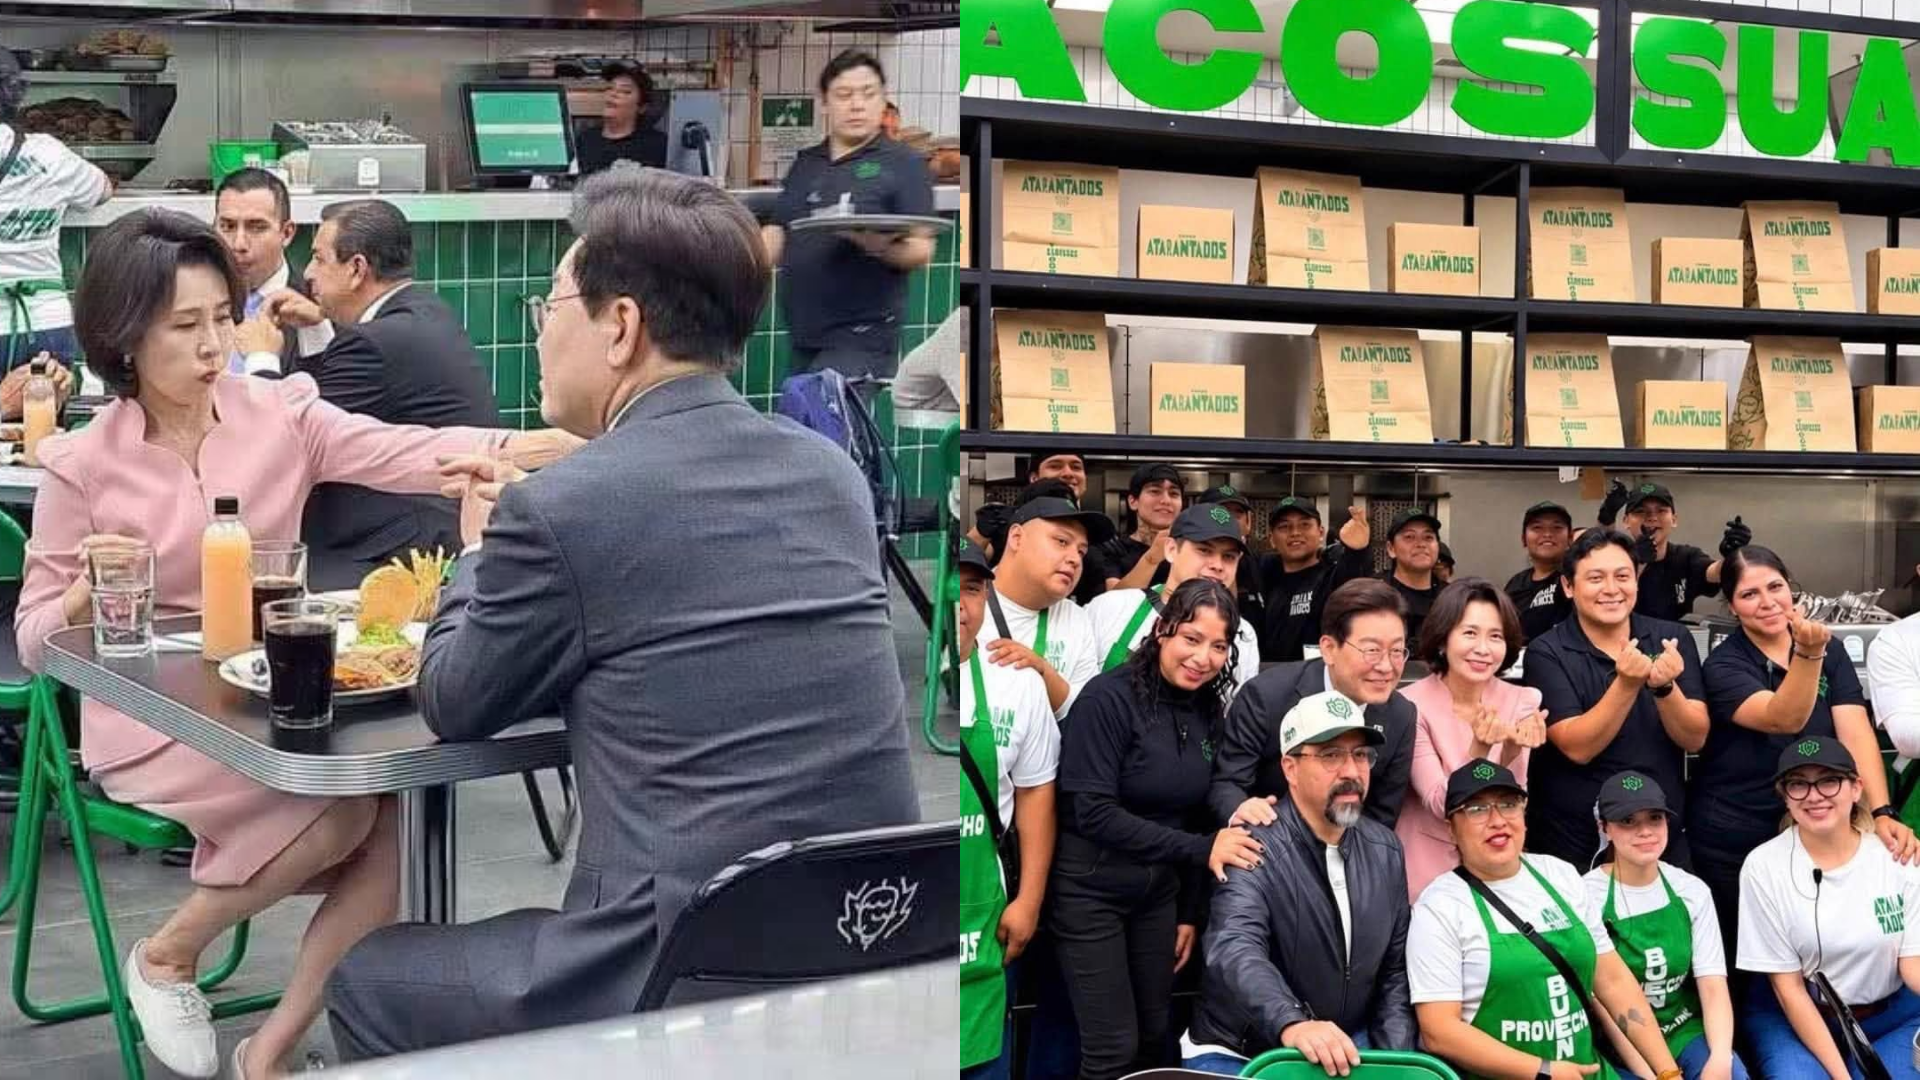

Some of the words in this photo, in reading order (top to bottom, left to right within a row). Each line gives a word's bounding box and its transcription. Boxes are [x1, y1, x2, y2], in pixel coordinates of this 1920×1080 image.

[1633, 17, 1920, 167] SUA
[1021, 176, 1103, 197] ATARANTADOS
[1277, 190, 1350, 213] ATARANTADOS
[1542, 209, 1614, 228] ATARANTADOS
[1764, 220, 1832, 236] ATARANTADOS
[1146, 237, 1227, 259] ATARANTADOS
[1401, 253, 1475, 274] ATARANTADOS
[1668, 266, 1738, 285] ATARANTADOS
[1018, 330, 1096, 351] ATARANTADOS
[1340, 345, 1413, 363] ATARANTADOS
[1532, 354, 1600, 371] ATARANTADOS
[1771, 357, 1834, 374] ATARANTADOS
[1159, 393, 1239, 413] ATARANTADOS
[1652, 409, 1722, 427] ATARANTADOS
[1501, 1009, 1590, 1042] PROVECH
[1546, 973, 1575, 1061] BUEN
